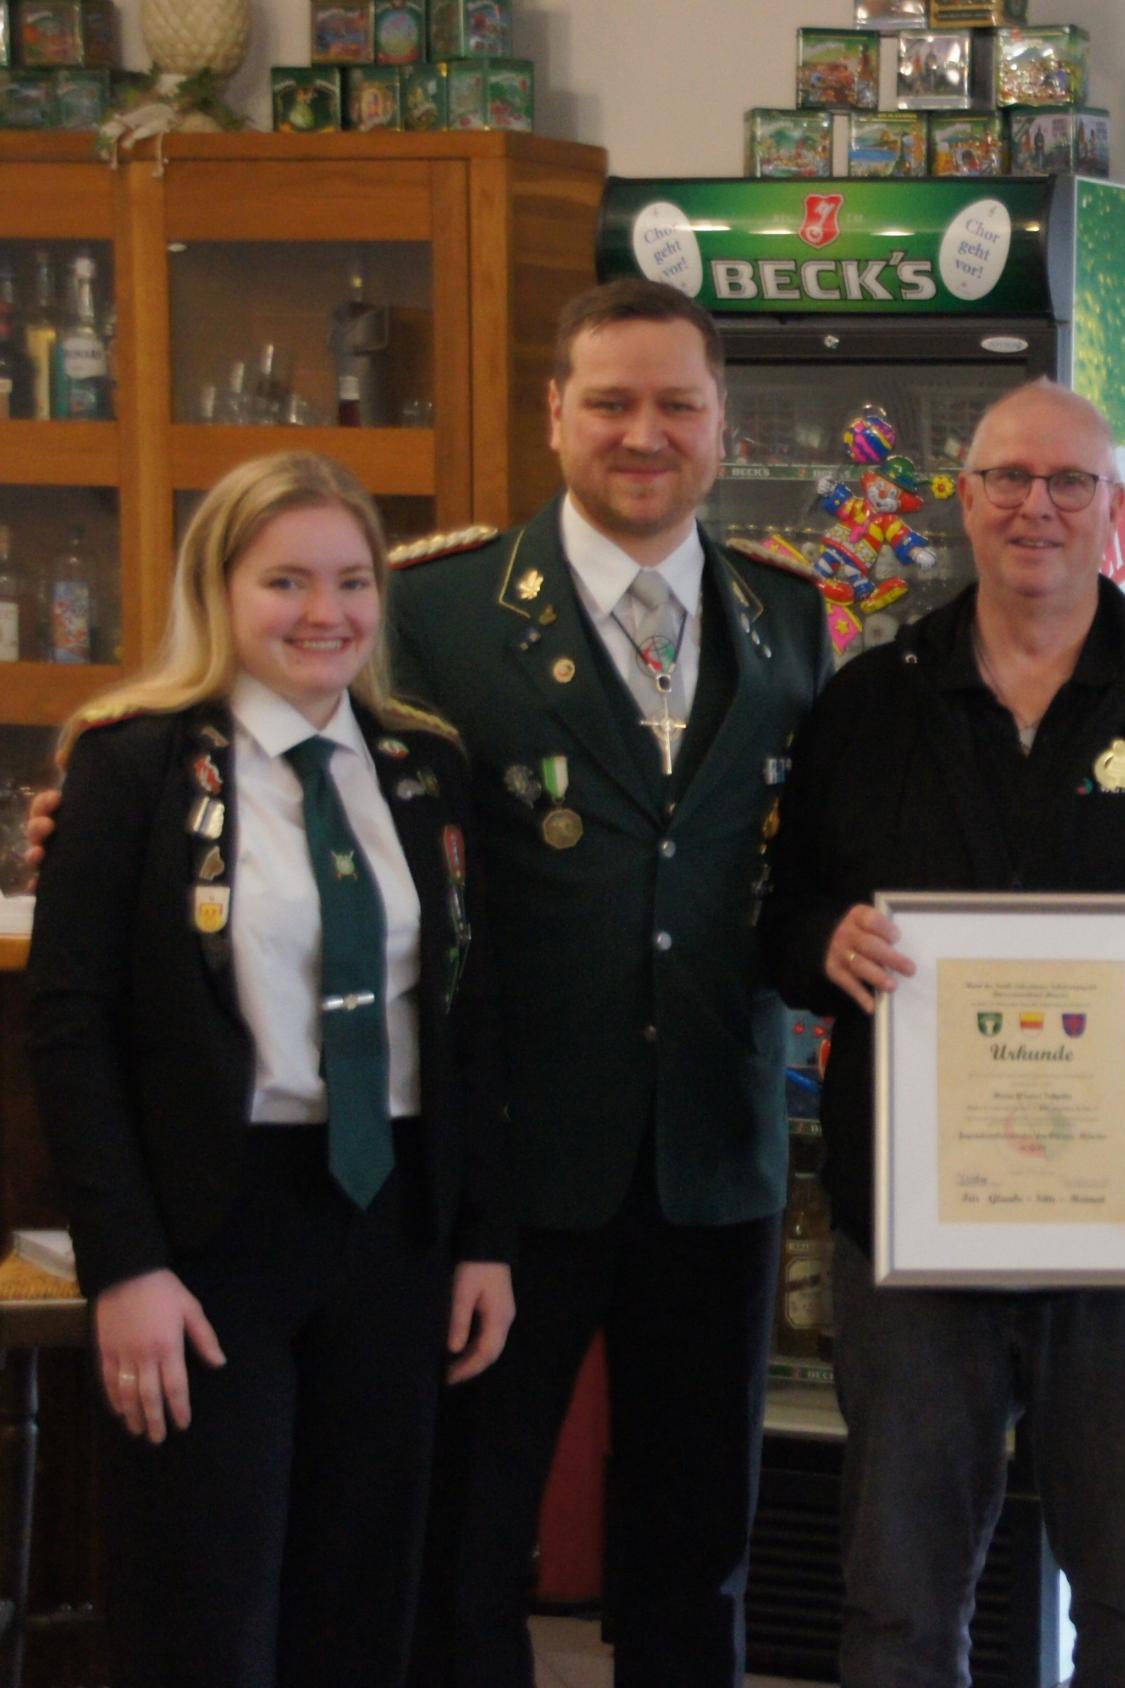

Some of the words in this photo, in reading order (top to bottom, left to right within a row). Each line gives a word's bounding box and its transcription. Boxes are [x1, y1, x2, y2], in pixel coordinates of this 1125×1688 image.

[643, 223, 677, 244] Cho
[964, 218, 1001, 245] Chor
[653, 240, 683, 267] geht
[957, 239, 992, 262] geht
[662, 256, 689, 280] vor!
[710, 250, 938, 301] BECK'S
[954, 257, 985, 280] vor!
[989, 1042, 1074, 1062] Urkunde
